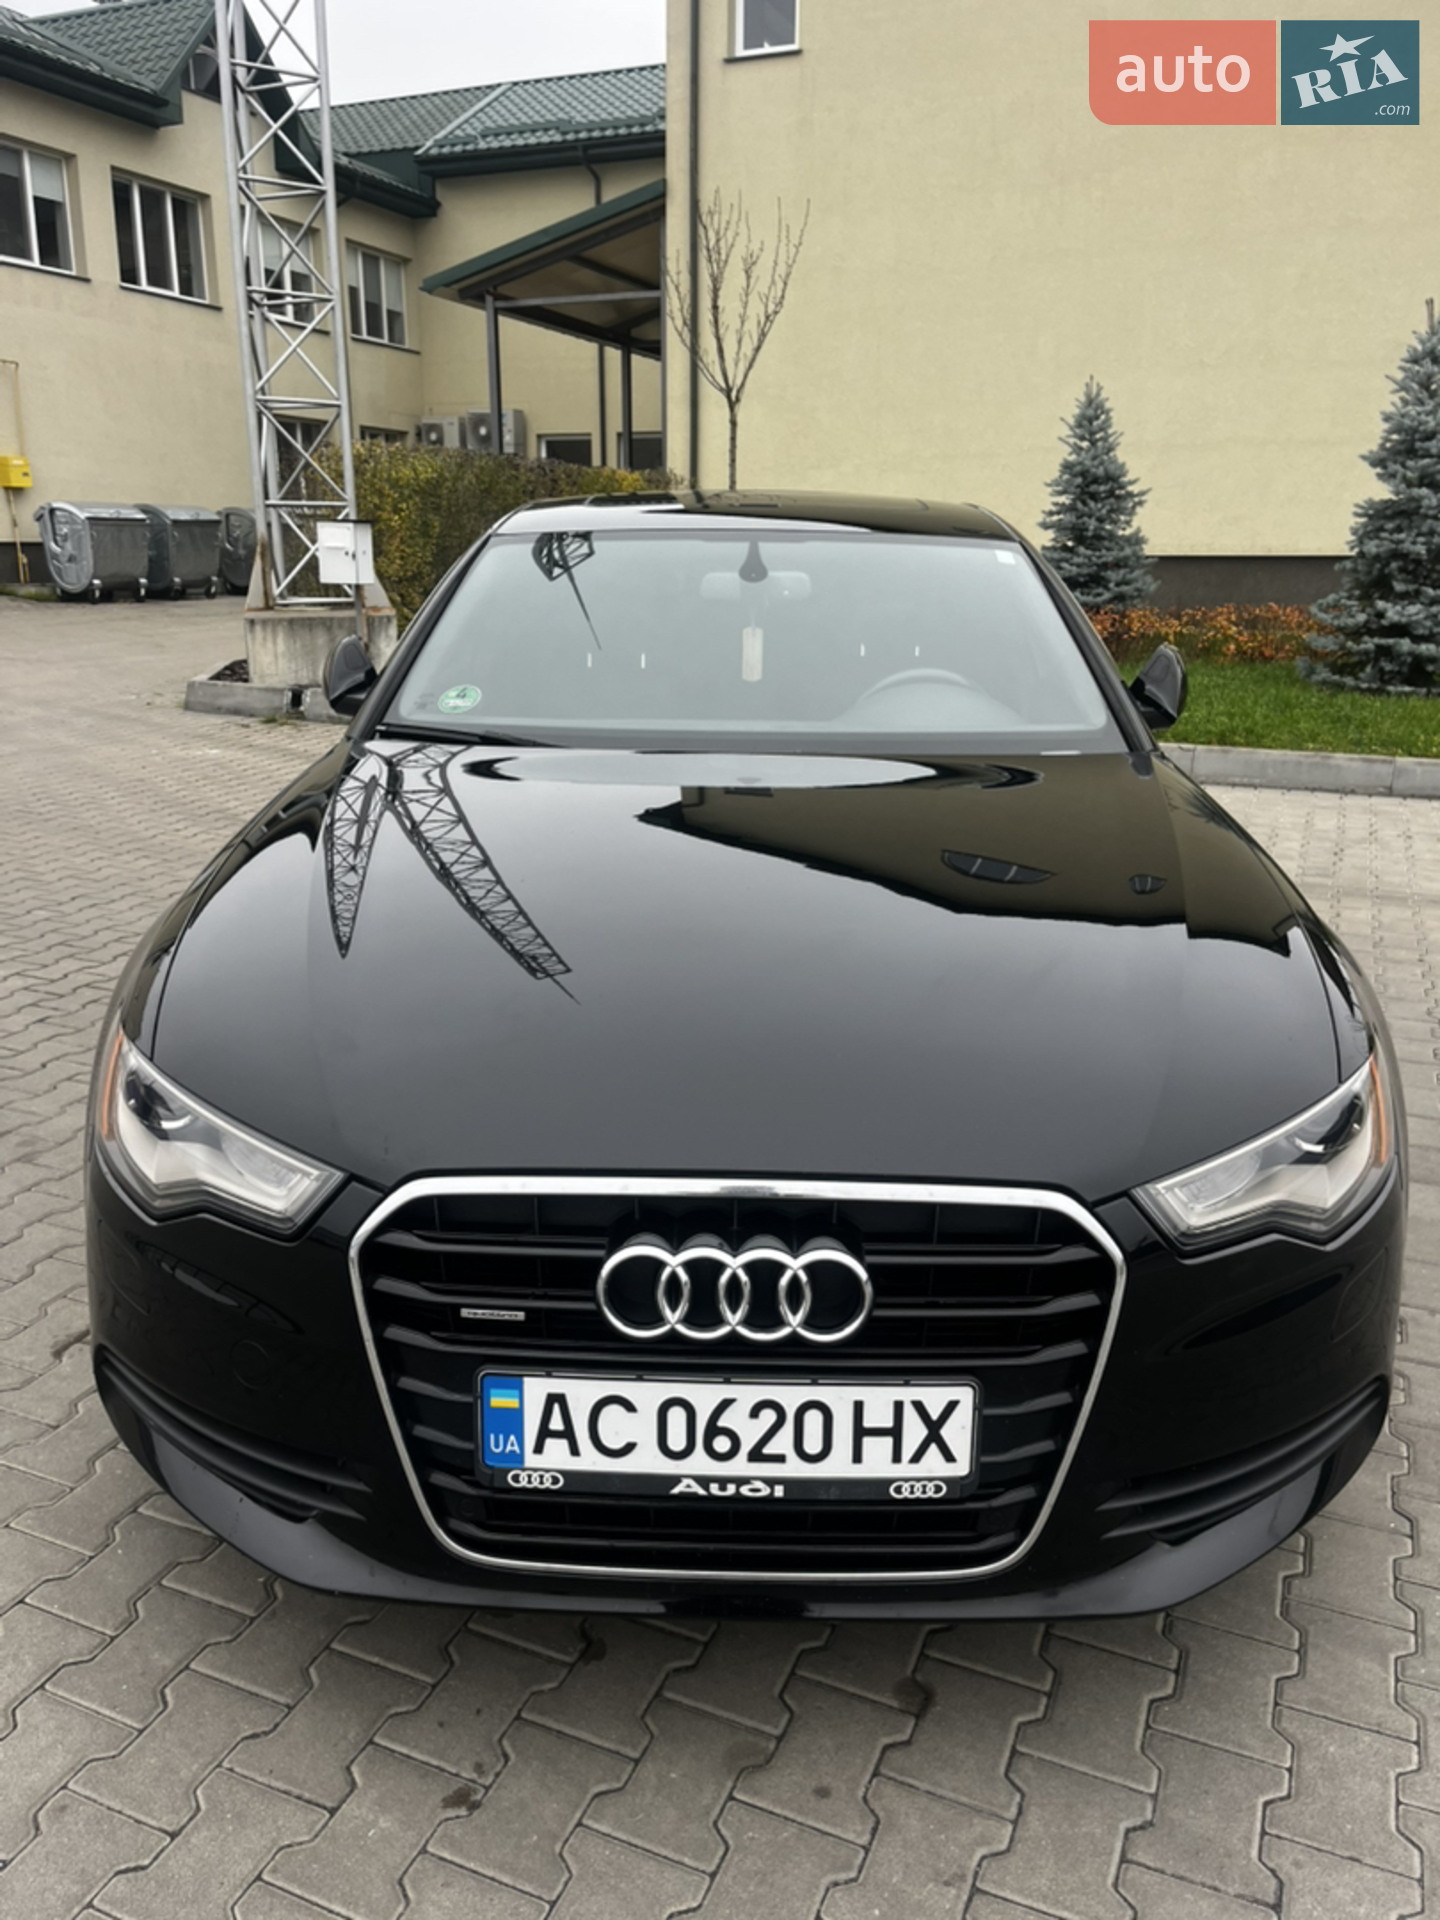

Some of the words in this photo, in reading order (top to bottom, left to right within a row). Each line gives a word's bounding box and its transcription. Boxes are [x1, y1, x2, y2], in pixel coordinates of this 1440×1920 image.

[532, 1392, 638, 1459] AC
[656, 1396, 834, 1464] 0620
[851, 1399, 961, 1465] HX
[489, 1433, 521, 1455] UA
[669, 1477, 785, 1498] Audi
